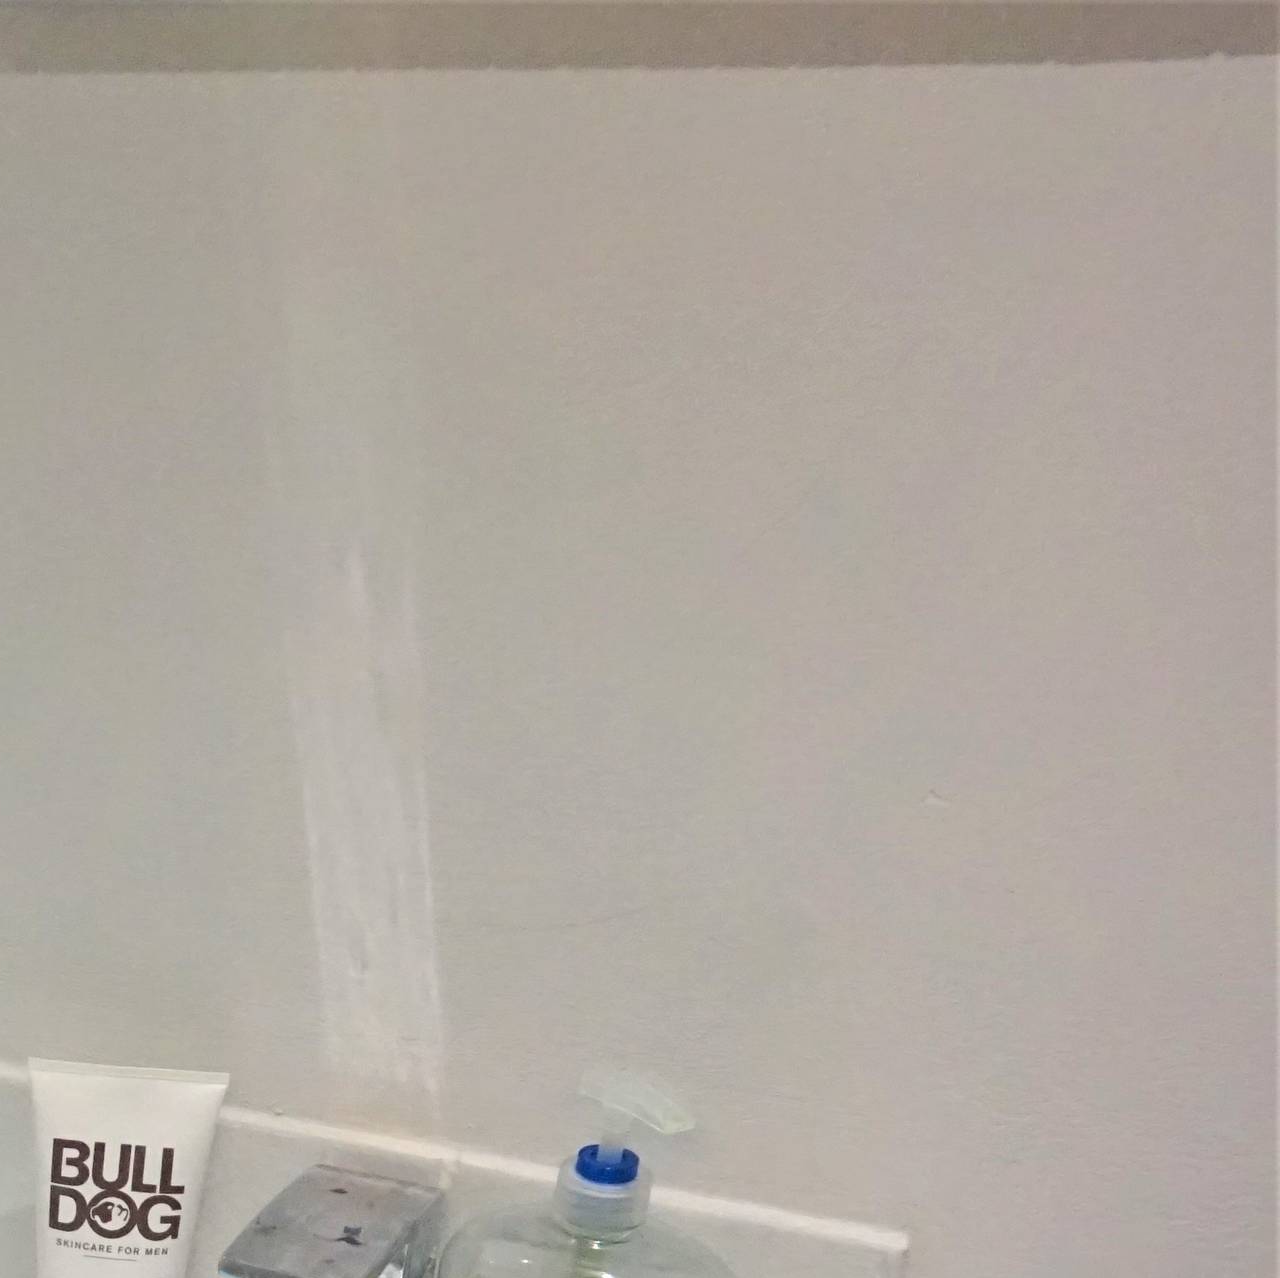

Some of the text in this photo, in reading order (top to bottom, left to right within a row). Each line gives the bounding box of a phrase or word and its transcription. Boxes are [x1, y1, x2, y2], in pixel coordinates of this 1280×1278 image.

[50, 1138, 185, 1194] BULL
[48, 1184, 182, 1241] DOG
[56, 1238, 168, 1256] SKINCARE FOR MEN
